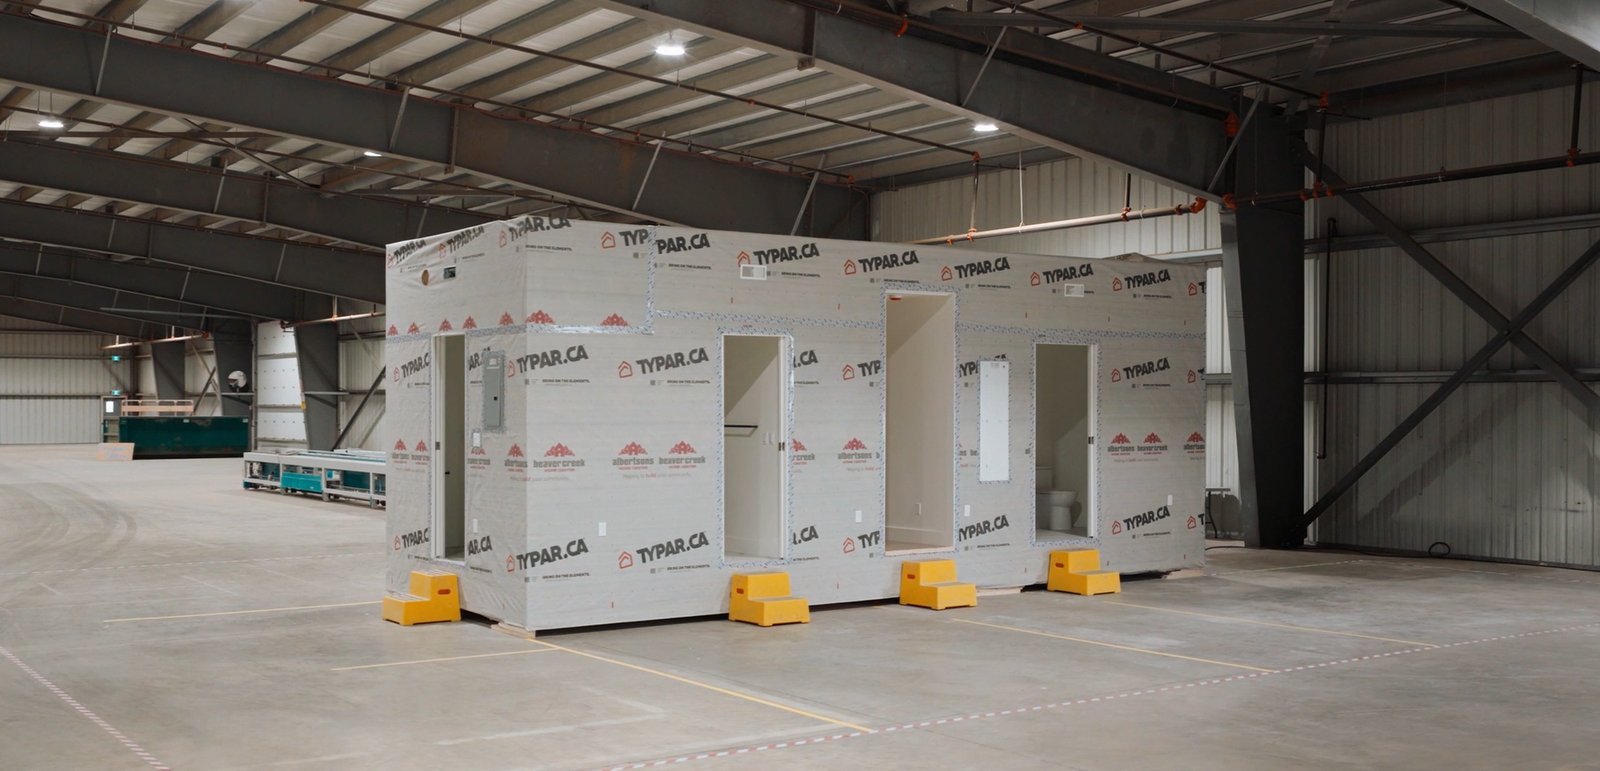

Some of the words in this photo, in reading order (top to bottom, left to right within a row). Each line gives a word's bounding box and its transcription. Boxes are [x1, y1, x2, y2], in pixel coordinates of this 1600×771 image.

[753, 242, 820, 266] TYPAR.CA
[857, 250, 920, 273] TYPAR.CA
[954, 256, 1011, 279] TYPAR.CA
[1042, 263, 1094, 284] TYPAR.CA
[1124, 269, 1172, 290] TYPAR.CA
[516, 344, 589, 374] TYPAR.CA
[636, 347, 709, 375] TYPAR.CA
[1122, 357, 1171, 380] TYPAR.CA
[1122, 505, 1171, 532] TYPAR.CA
[515, 538, 589, 571] TYPAR.CA
[635, 531, 710, 564] TYPAR.CA
